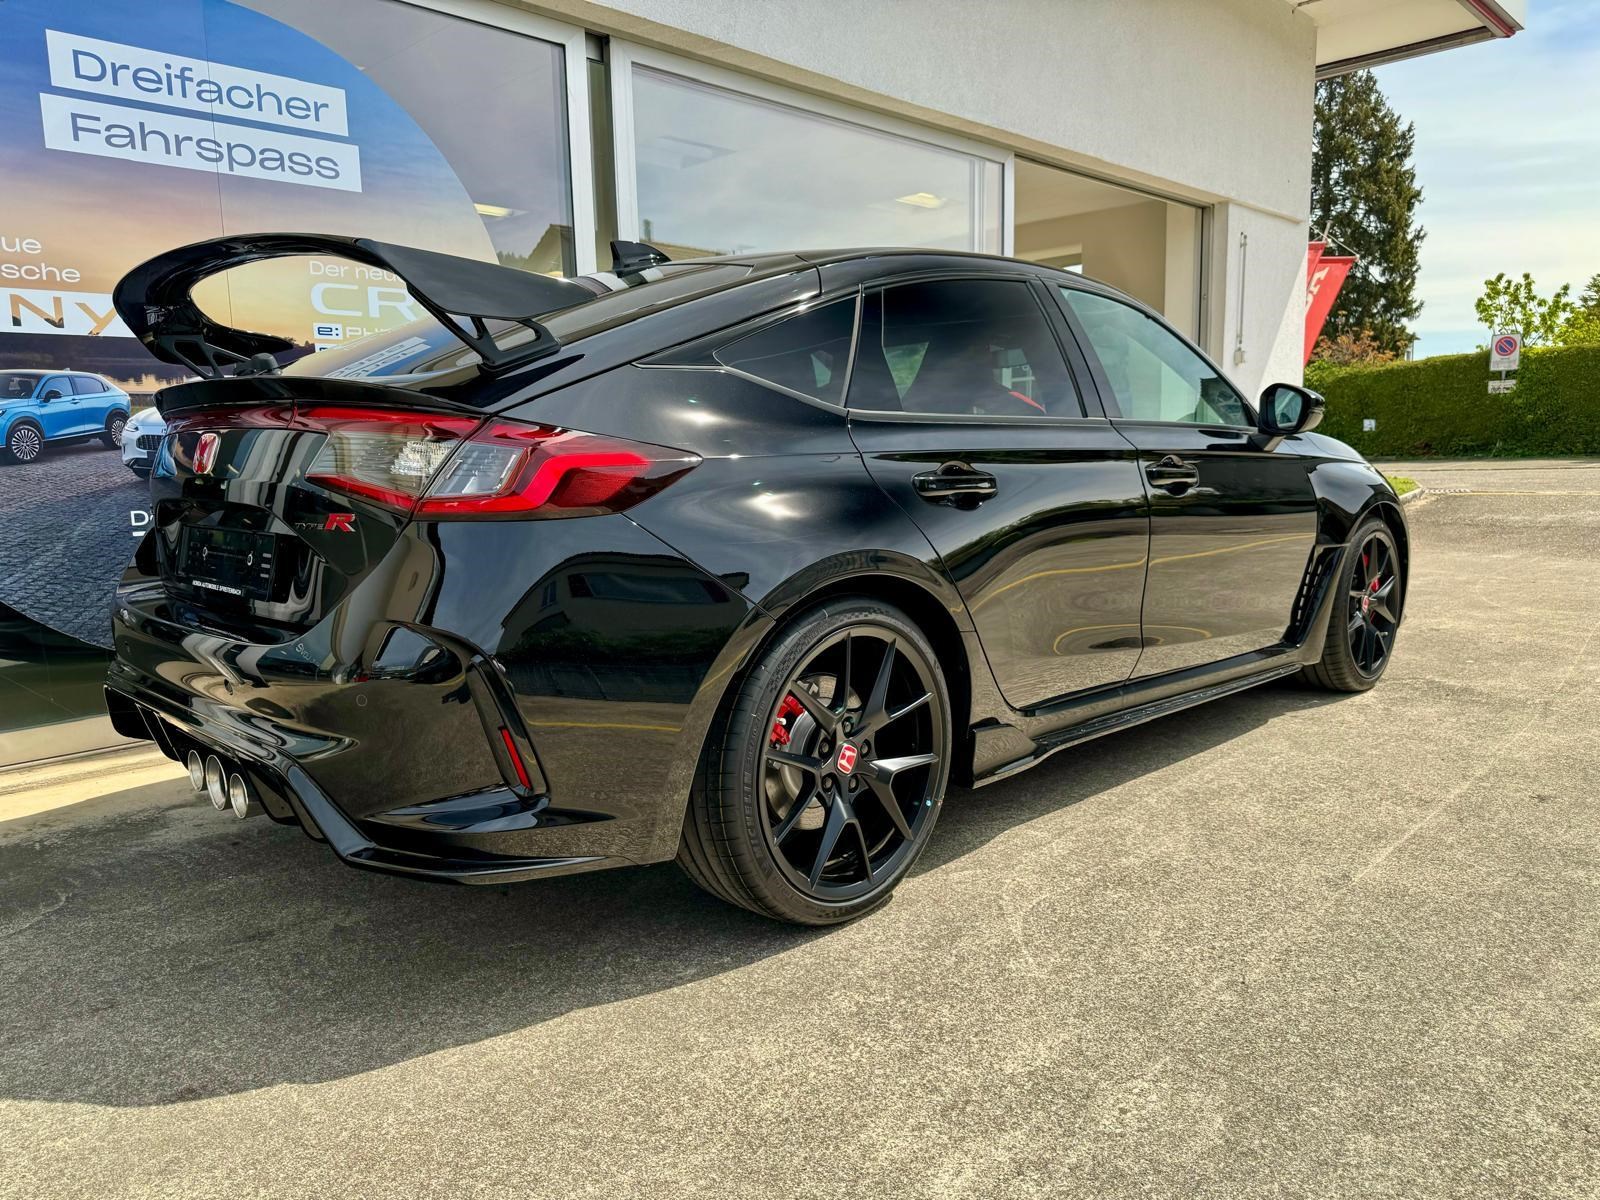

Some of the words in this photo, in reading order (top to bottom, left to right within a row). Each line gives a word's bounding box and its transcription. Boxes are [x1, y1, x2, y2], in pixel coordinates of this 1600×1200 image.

[71, 48, 330, 122] Dreifacher
[69, 112, 341, 180] Fahrspass
[309, 260, 349, 278] Der
[324, 513, 357, 532] R
